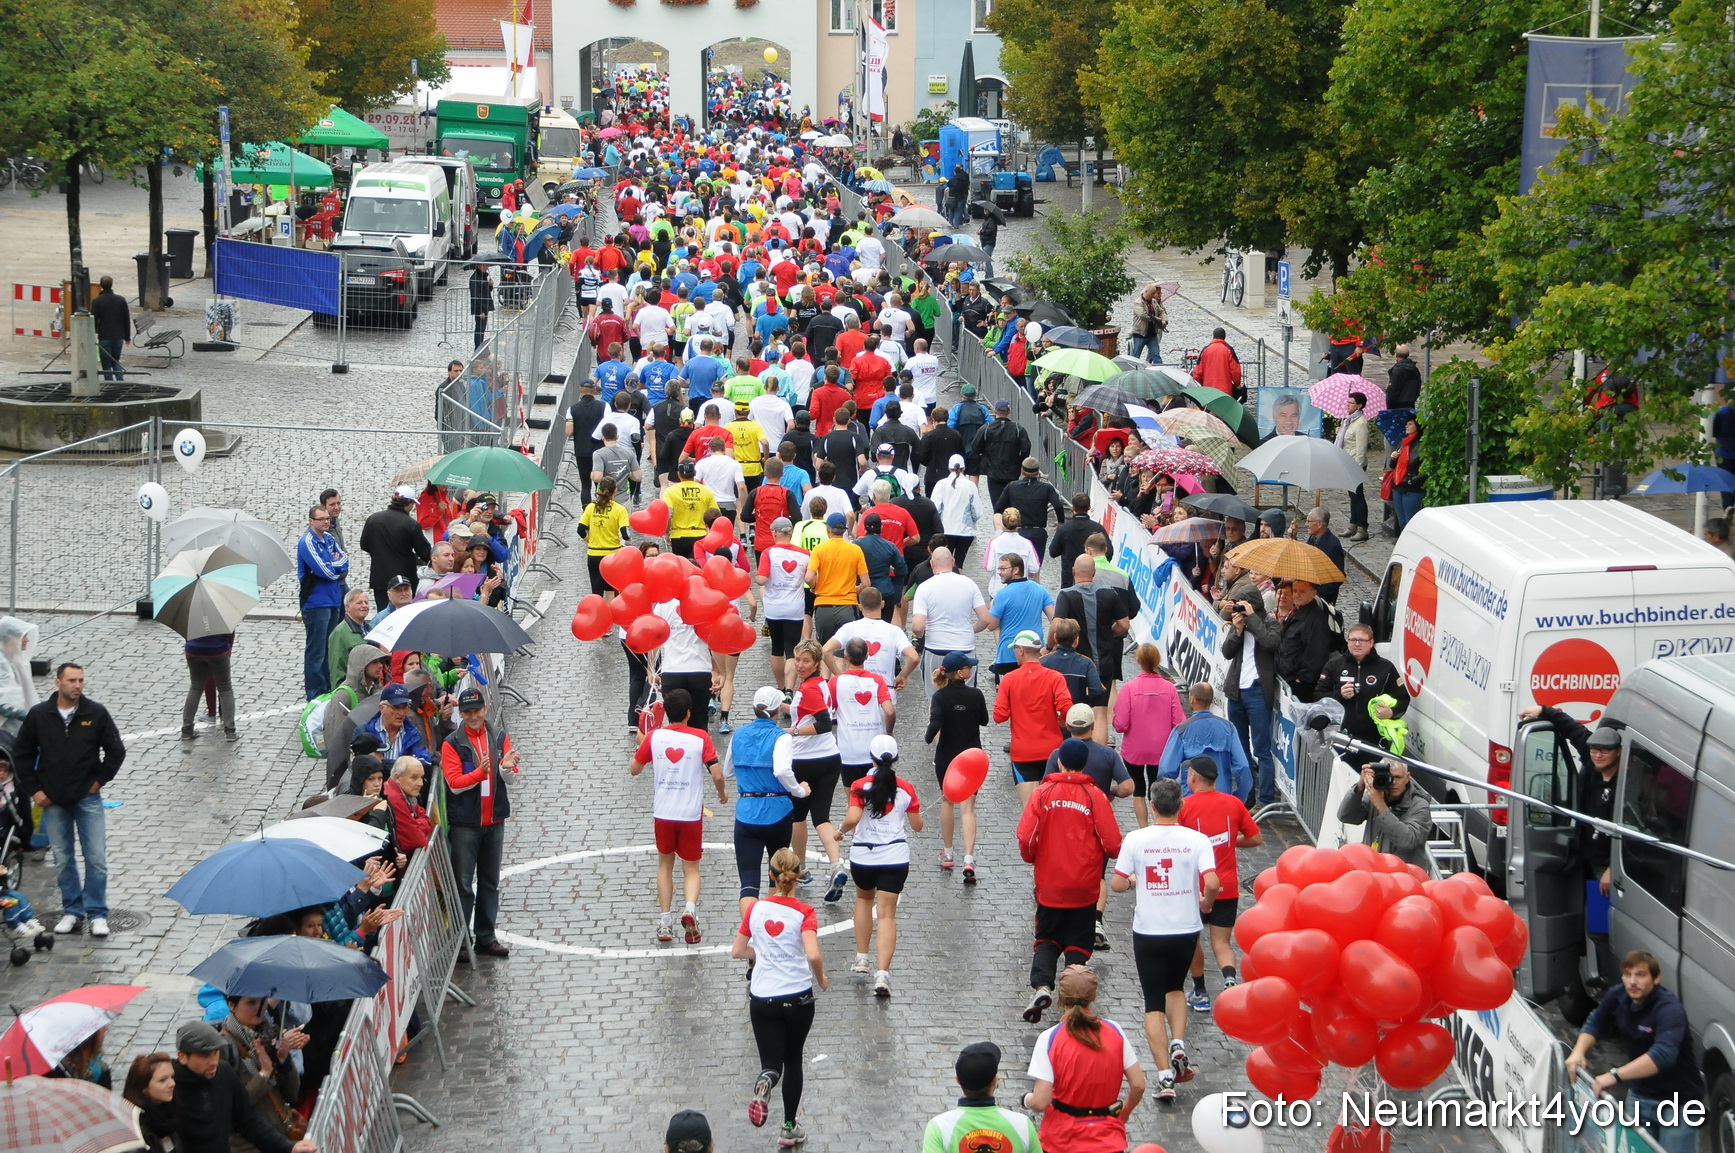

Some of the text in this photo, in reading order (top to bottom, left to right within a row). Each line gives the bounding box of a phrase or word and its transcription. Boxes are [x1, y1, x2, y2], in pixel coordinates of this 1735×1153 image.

[282, 224, 288, 233] P
[1280, 266, 1288, 291] P
[681, 487, 700, 498] MTP
[1437, 558, 1508, 620] www.buchbinder.de
[1536, 603, 1735, 628] www.buchbinder.de
[1404, 605, 1436, 649] BUCHBINDER
[1652, 636, 1733, 660] PKW
[1531, 674, 1620, 690] BUCHBINDER
[1051, 800, 1061, 808] FC
[1062, 800, 1091, 816] DEINING
[1148, 881, 1168, 890] DKMS
